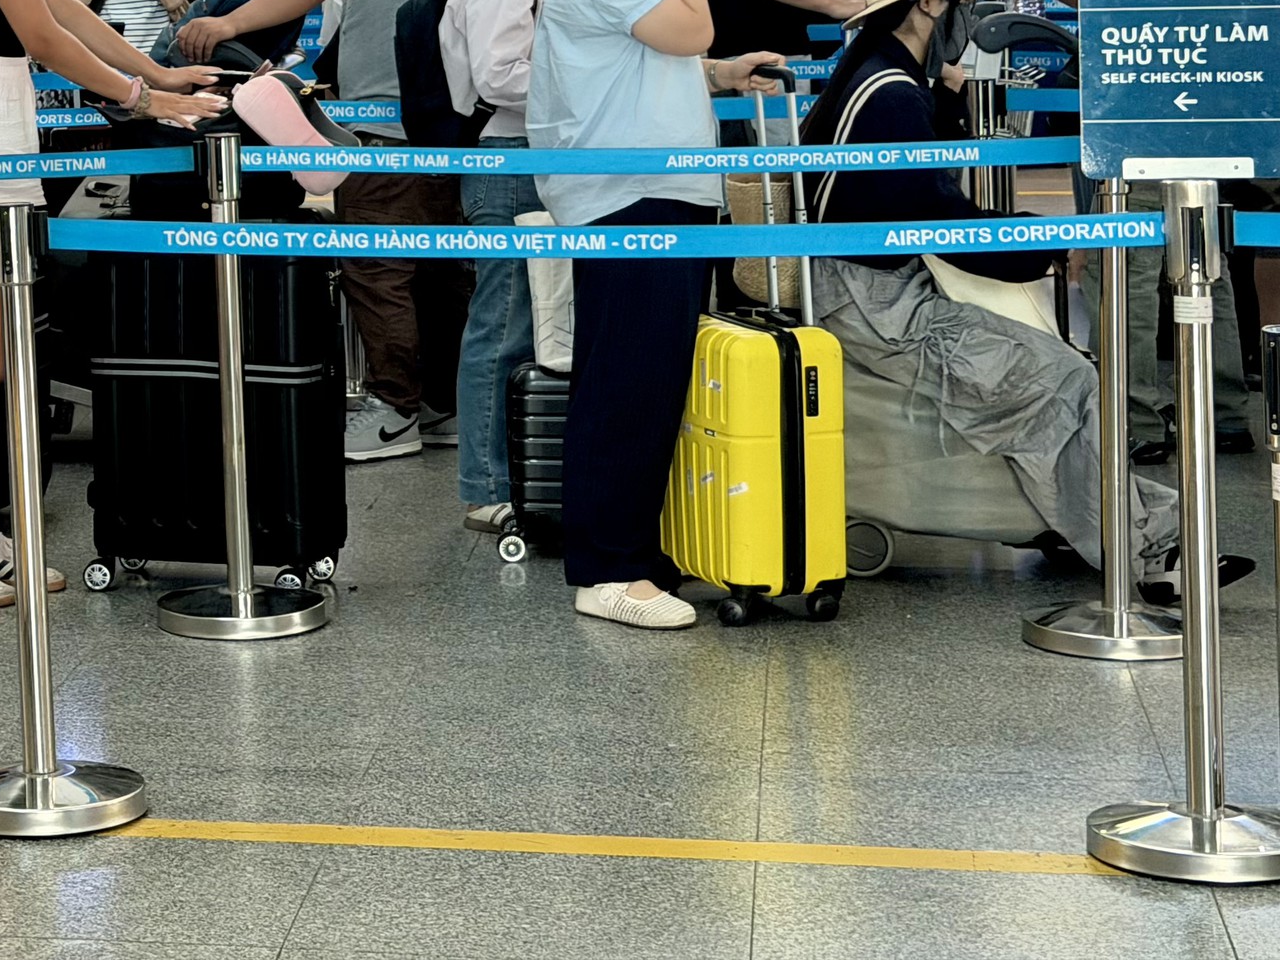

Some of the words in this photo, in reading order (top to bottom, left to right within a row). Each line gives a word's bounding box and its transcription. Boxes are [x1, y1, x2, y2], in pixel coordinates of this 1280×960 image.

[1101, 22, 1169, 46] QUẦY
[1174, 23, 1209, 47] TỰ
[1215, 22, 1269, 42] LÀM
[1101, 44, 1152, 66] THỦ
[1158, 47, 1208, 69] TỤC
[1101, 72, 1137, 85] SELF
[1140, 71, 1213, 84] CHECK-IN
[1216, 70, 1265, 83] KIOSK
[16, 160, 37, 173] OF
[41, 157, 106, 171] VIETNAM
[266, 149, 310, 167] HÀNG
[315, 150, 372, 166] KHÔNG
[376, 153, 410, 170] VIỆT
[413, 155, 449, 167] NAM
[462, 154, 505, 168] CTCP
[666, 154, 749, 168] AIRPORTS
[753, 151, 873, 167] CORPORATION
[878, 149, 901, 163] OF
[905, 147, 980, 162] VIETNAM
[163, 227, 218, 246] TỔNG
[222, 228, 279, 247] CÔNG
[284, 232, 309, 248] TY
[313, 228, 369, 249] CẢNG
[374, 230, 431, 250] HÀNG
[436, 230, 508, 251] KHÔNG
[512, 232, 556, 254] VIỆT
[562, 234, 606, 250] NAM
[623, 233, 679, 251] CTCP
[884, 226, 993, 246] AIRPORTS
[998, 222, 1156, 243] CORPORATION
